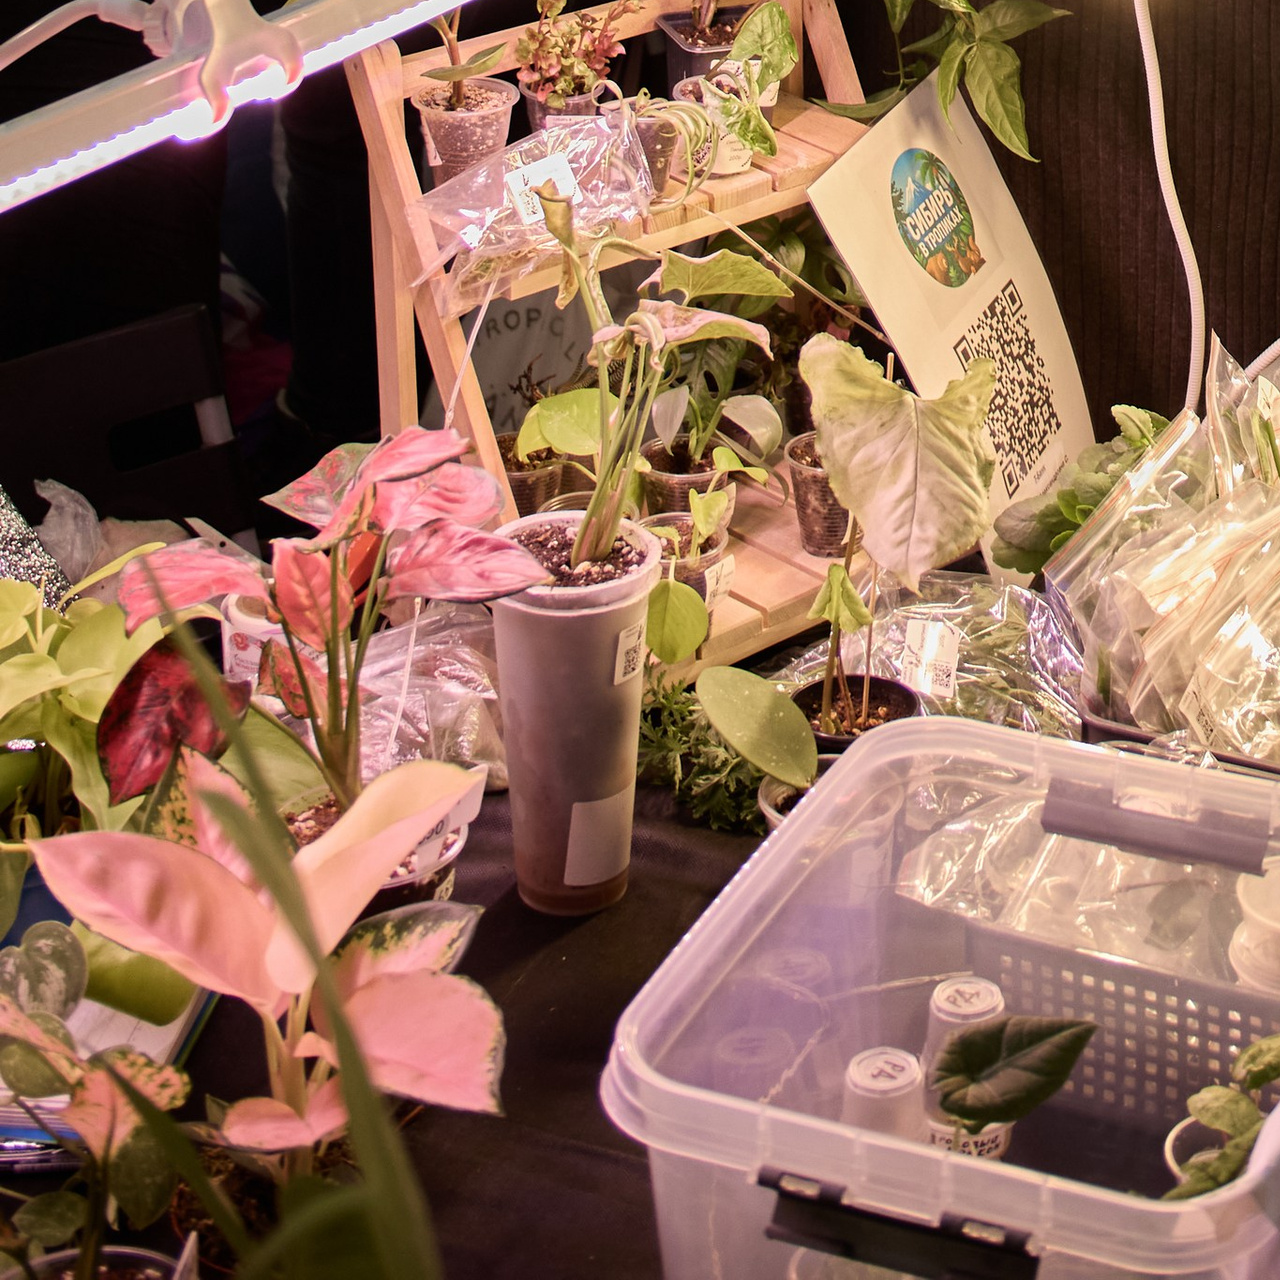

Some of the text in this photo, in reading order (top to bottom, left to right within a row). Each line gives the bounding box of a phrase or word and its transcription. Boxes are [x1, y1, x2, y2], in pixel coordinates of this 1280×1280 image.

[905, 185, 954, 241] СИБИРЬ
[918, 205, 964, 258] В ТРОПИКАХ
